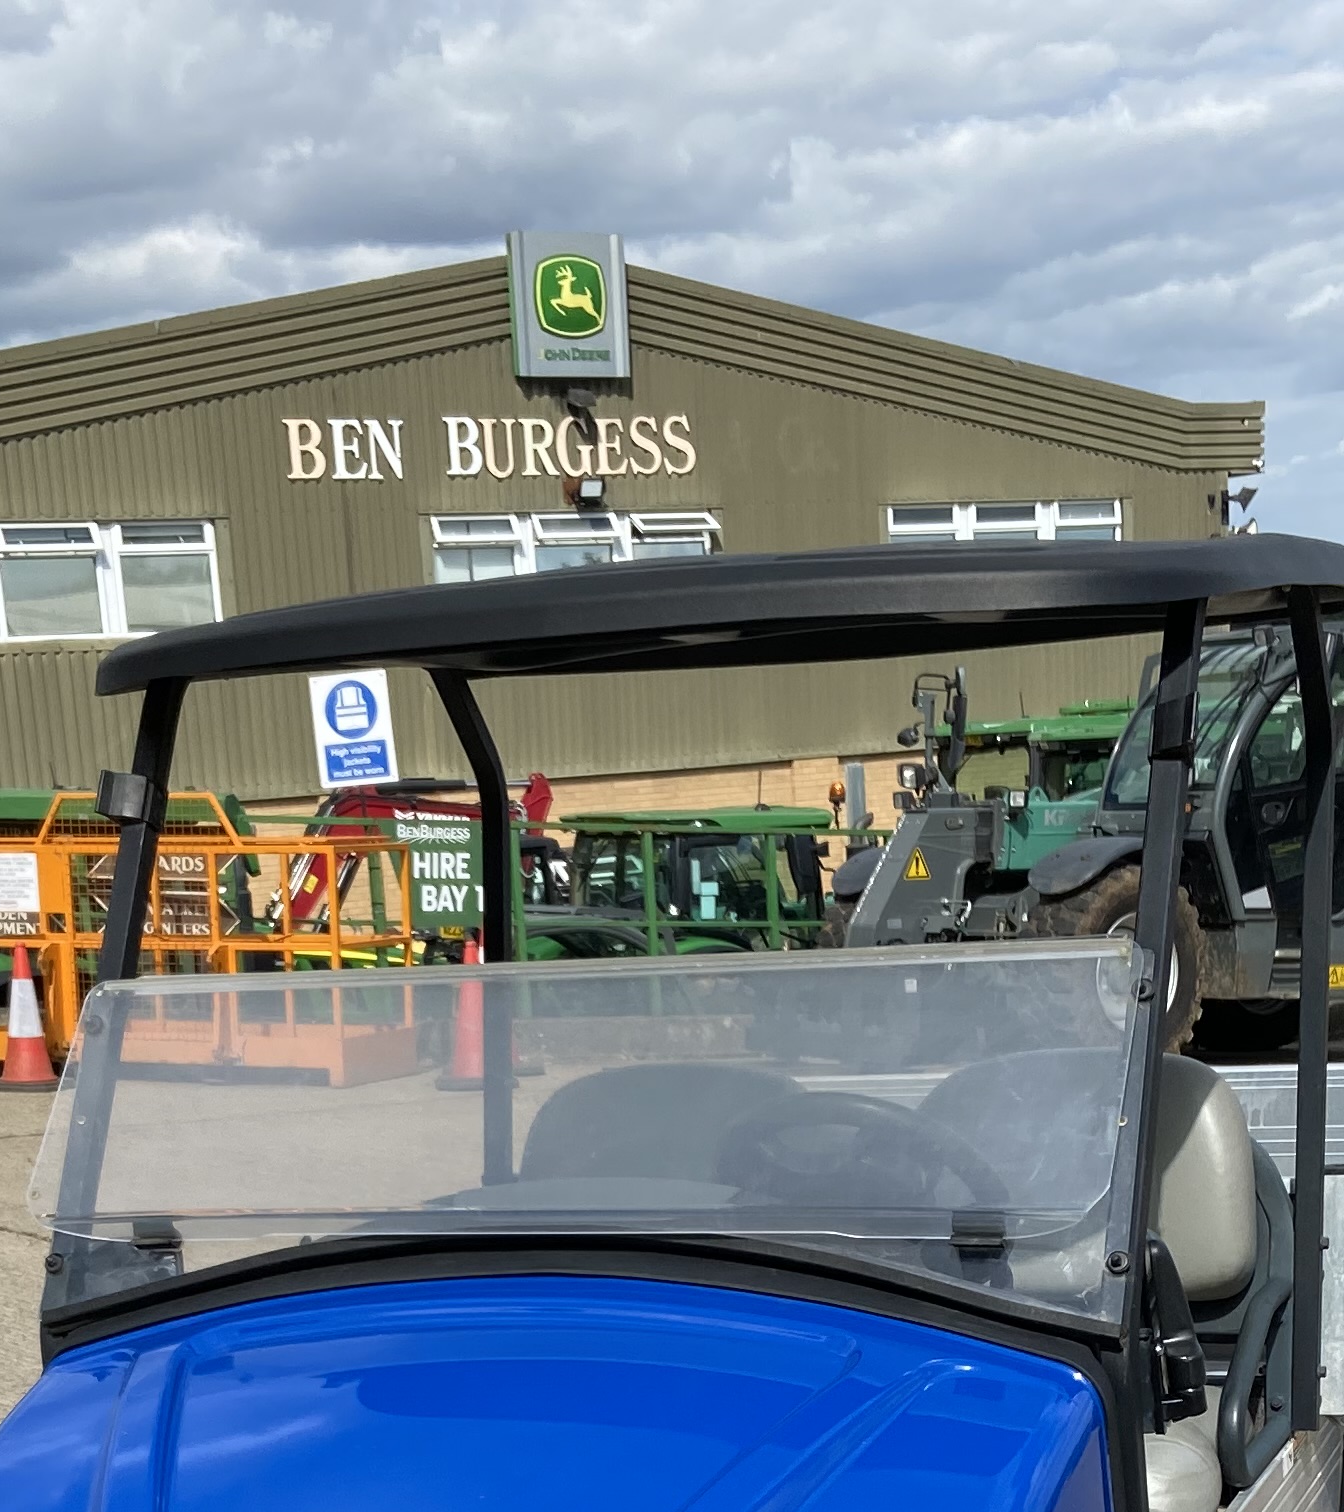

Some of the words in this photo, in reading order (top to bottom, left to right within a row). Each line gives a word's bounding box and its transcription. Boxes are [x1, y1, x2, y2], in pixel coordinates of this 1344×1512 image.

[538, 348, 570, 361] JOHN
[282, 418, 404, 481] BEN
[441, 414, 697, 480] BURGESS
[413, 851, 471, 880] HIRE
[421, 884, 469, 912] BAY
[474, 884, 484, 912] 1
